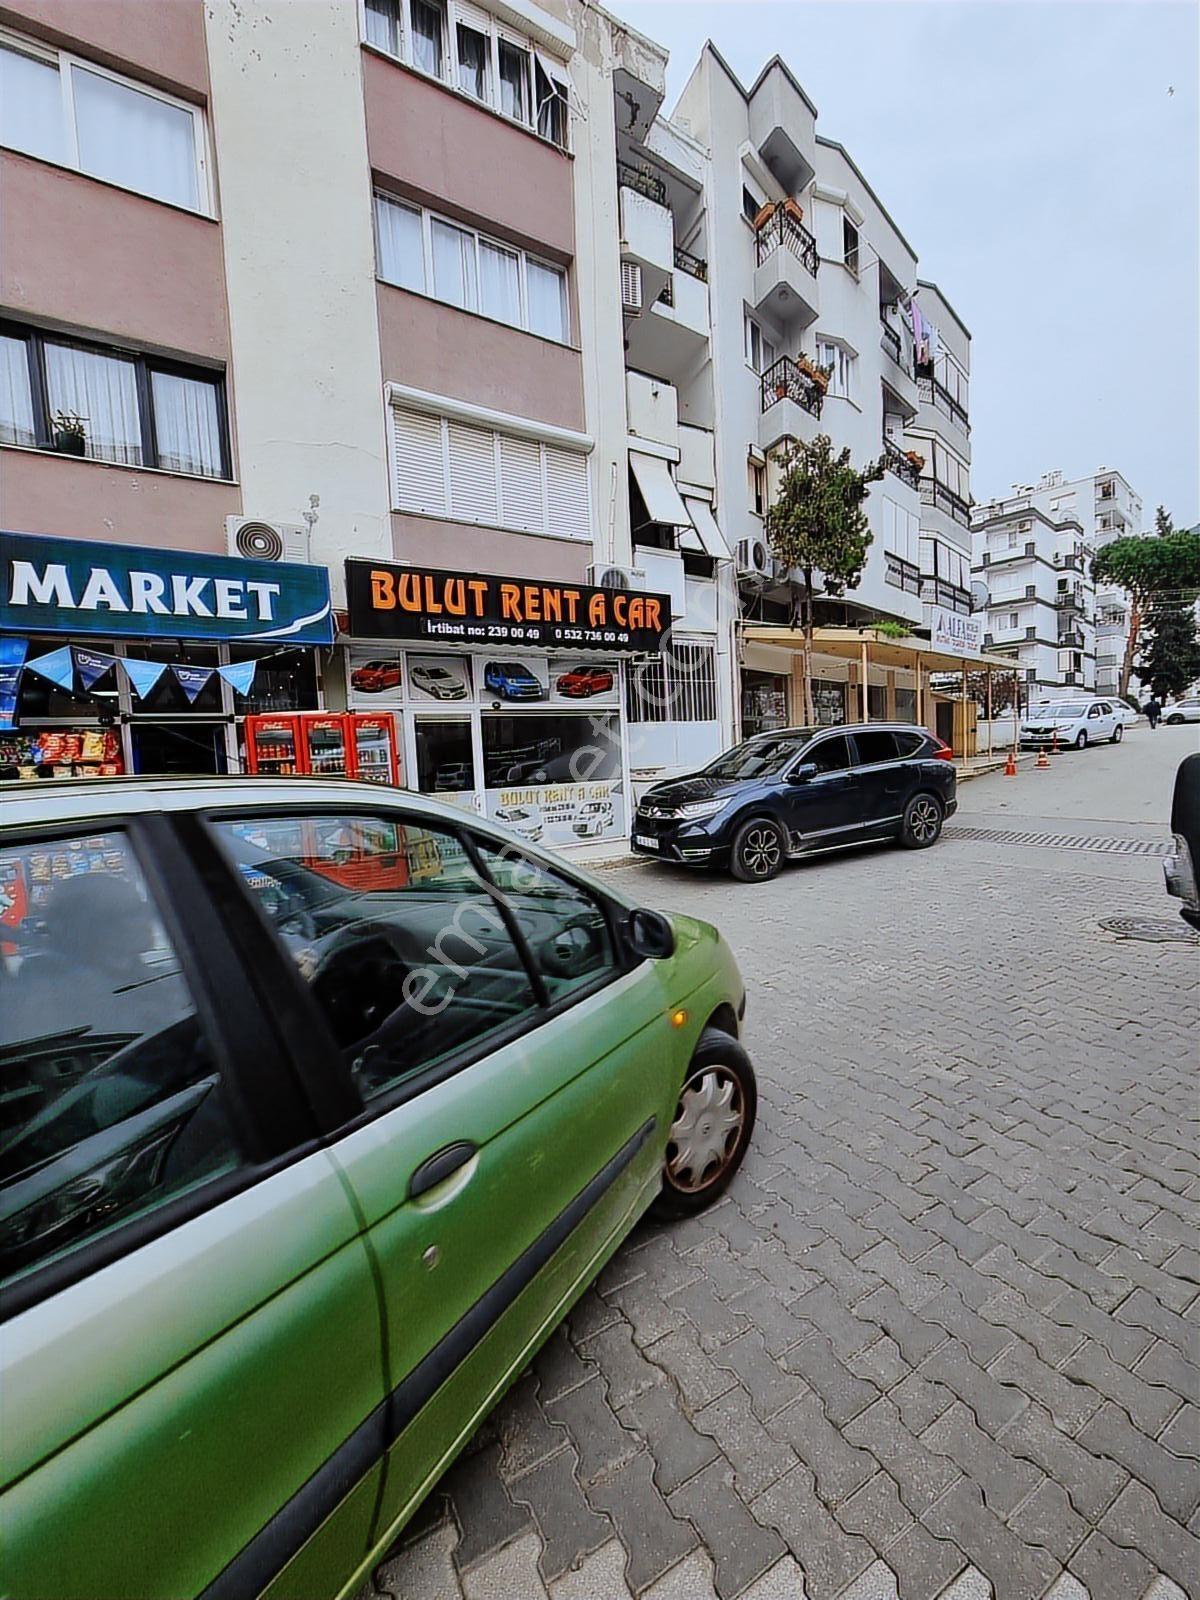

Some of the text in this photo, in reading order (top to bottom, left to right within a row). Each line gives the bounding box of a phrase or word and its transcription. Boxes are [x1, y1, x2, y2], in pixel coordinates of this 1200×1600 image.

[9, 560, 281, 621] MARKET
[370, 569, 662, 633] BULUT RENT A CAR
[467, 626, 485, 636] no:
[488, 625, 508, 637] 239
[510, 627, 524, 638] 00
[526, 629, 540, 639] 49
[555, 629, 562, 638] 0
[564, 629, 583, 640] 532
[604, 632, 615, 642] 00
[617, 633, 629, 643] 49
